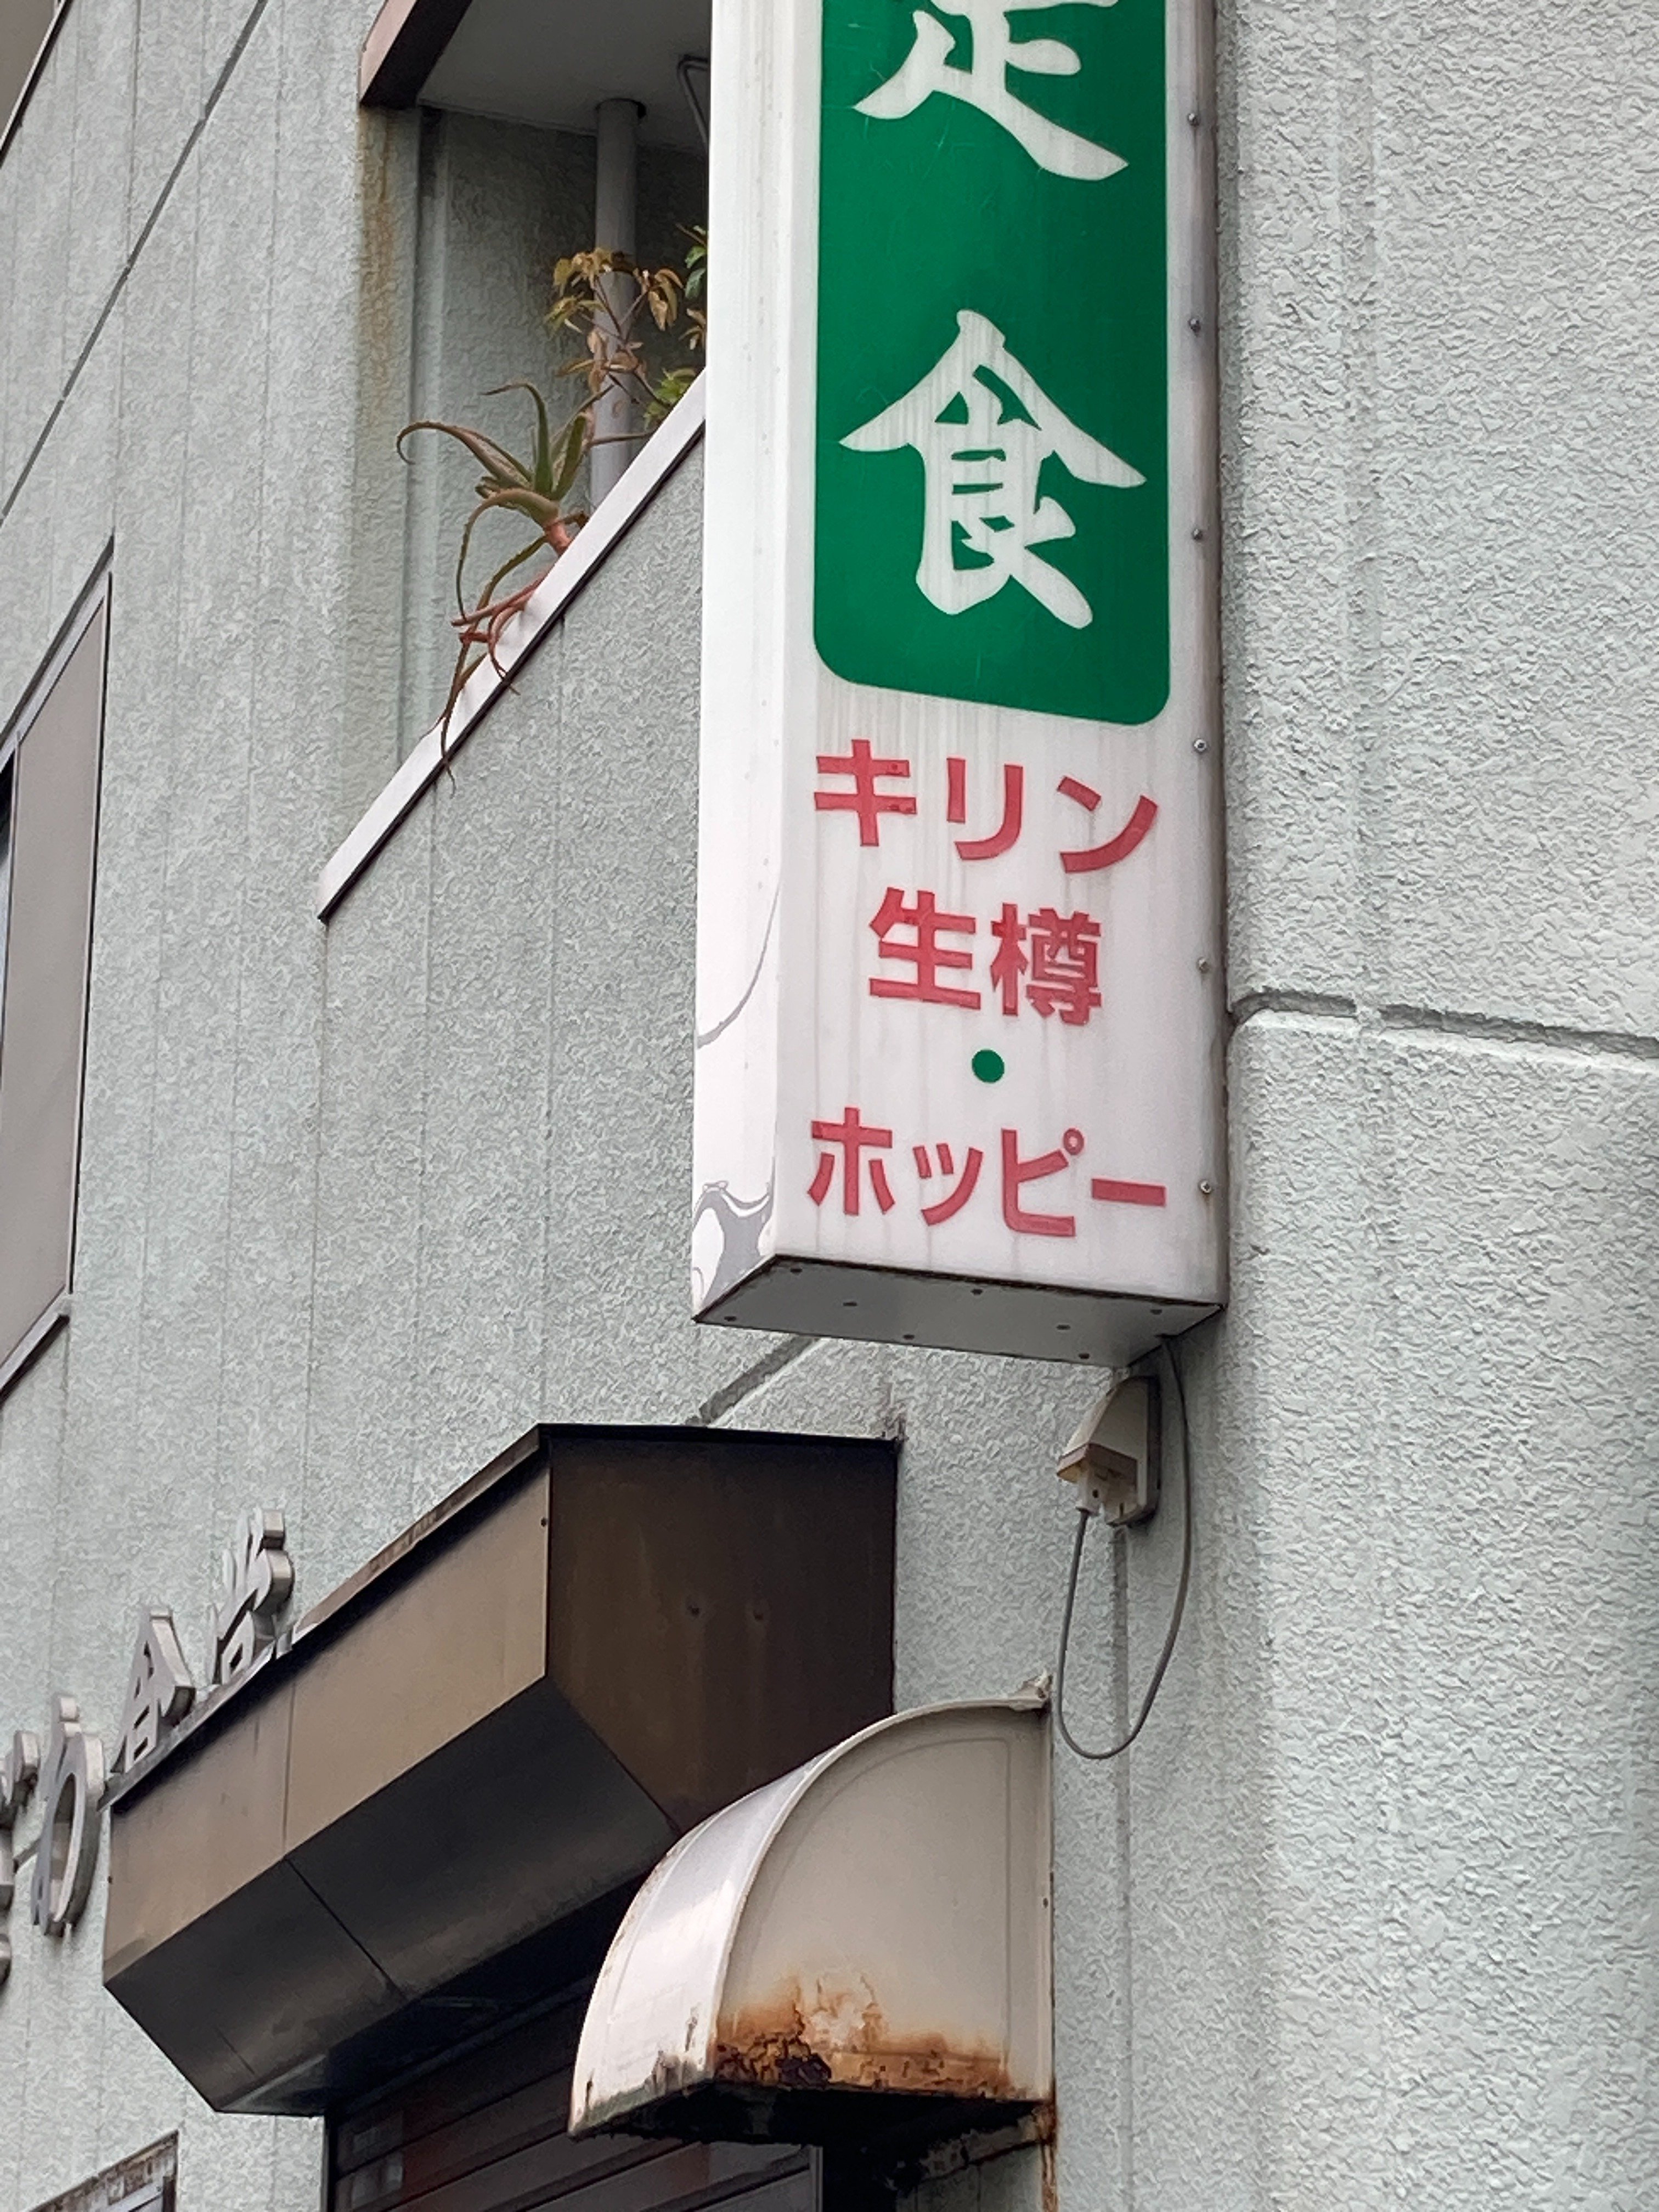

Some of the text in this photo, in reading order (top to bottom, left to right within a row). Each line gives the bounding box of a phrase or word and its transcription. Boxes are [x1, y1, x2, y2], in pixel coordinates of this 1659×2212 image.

[814, 739, 1157, 873] キリン
[869, 887, 1102, 1025] 生樽
[807, 1107, 1165, 1237] ホッピー
